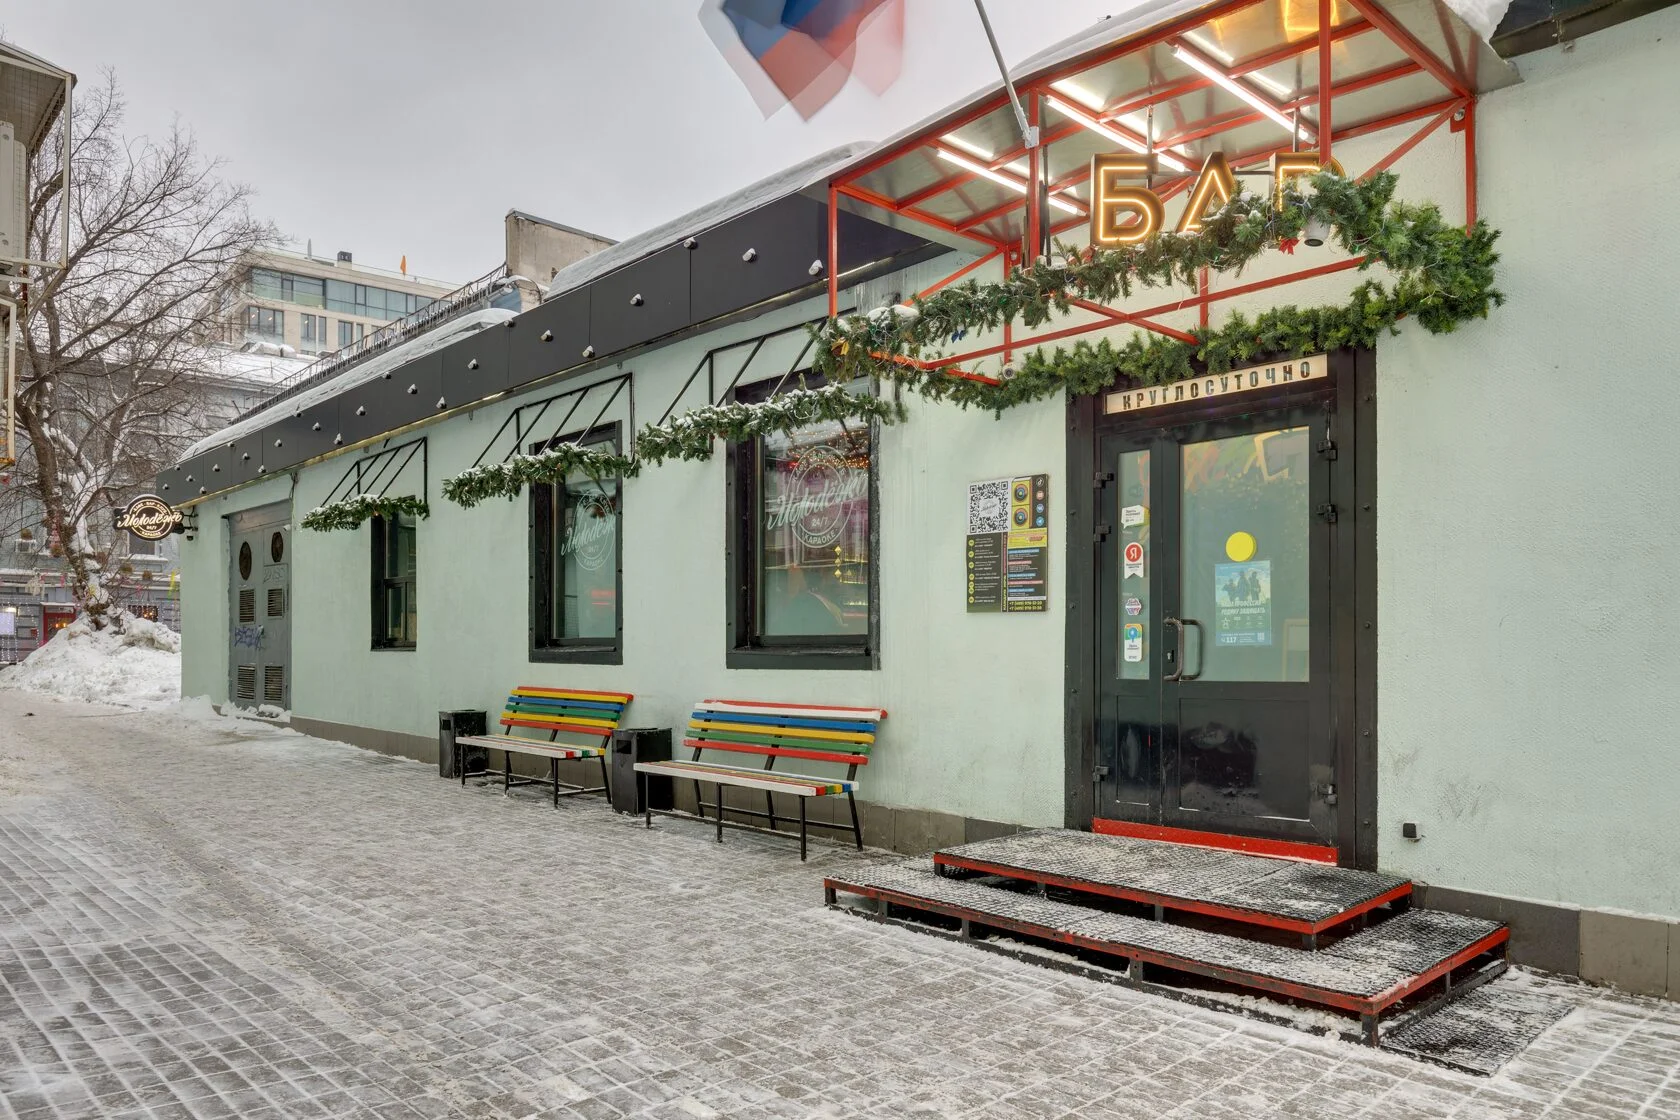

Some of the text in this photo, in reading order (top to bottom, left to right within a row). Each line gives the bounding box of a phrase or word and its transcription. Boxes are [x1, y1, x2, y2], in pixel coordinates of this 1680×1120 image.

[1122, 361, 1311, 410] КРУГЛОСУТОЧНО
[811, 516, 828, 527] 24/7
[804, 531, 836, 545] КАРАОКЕ
[1129, 547, 1137, 559] Я
